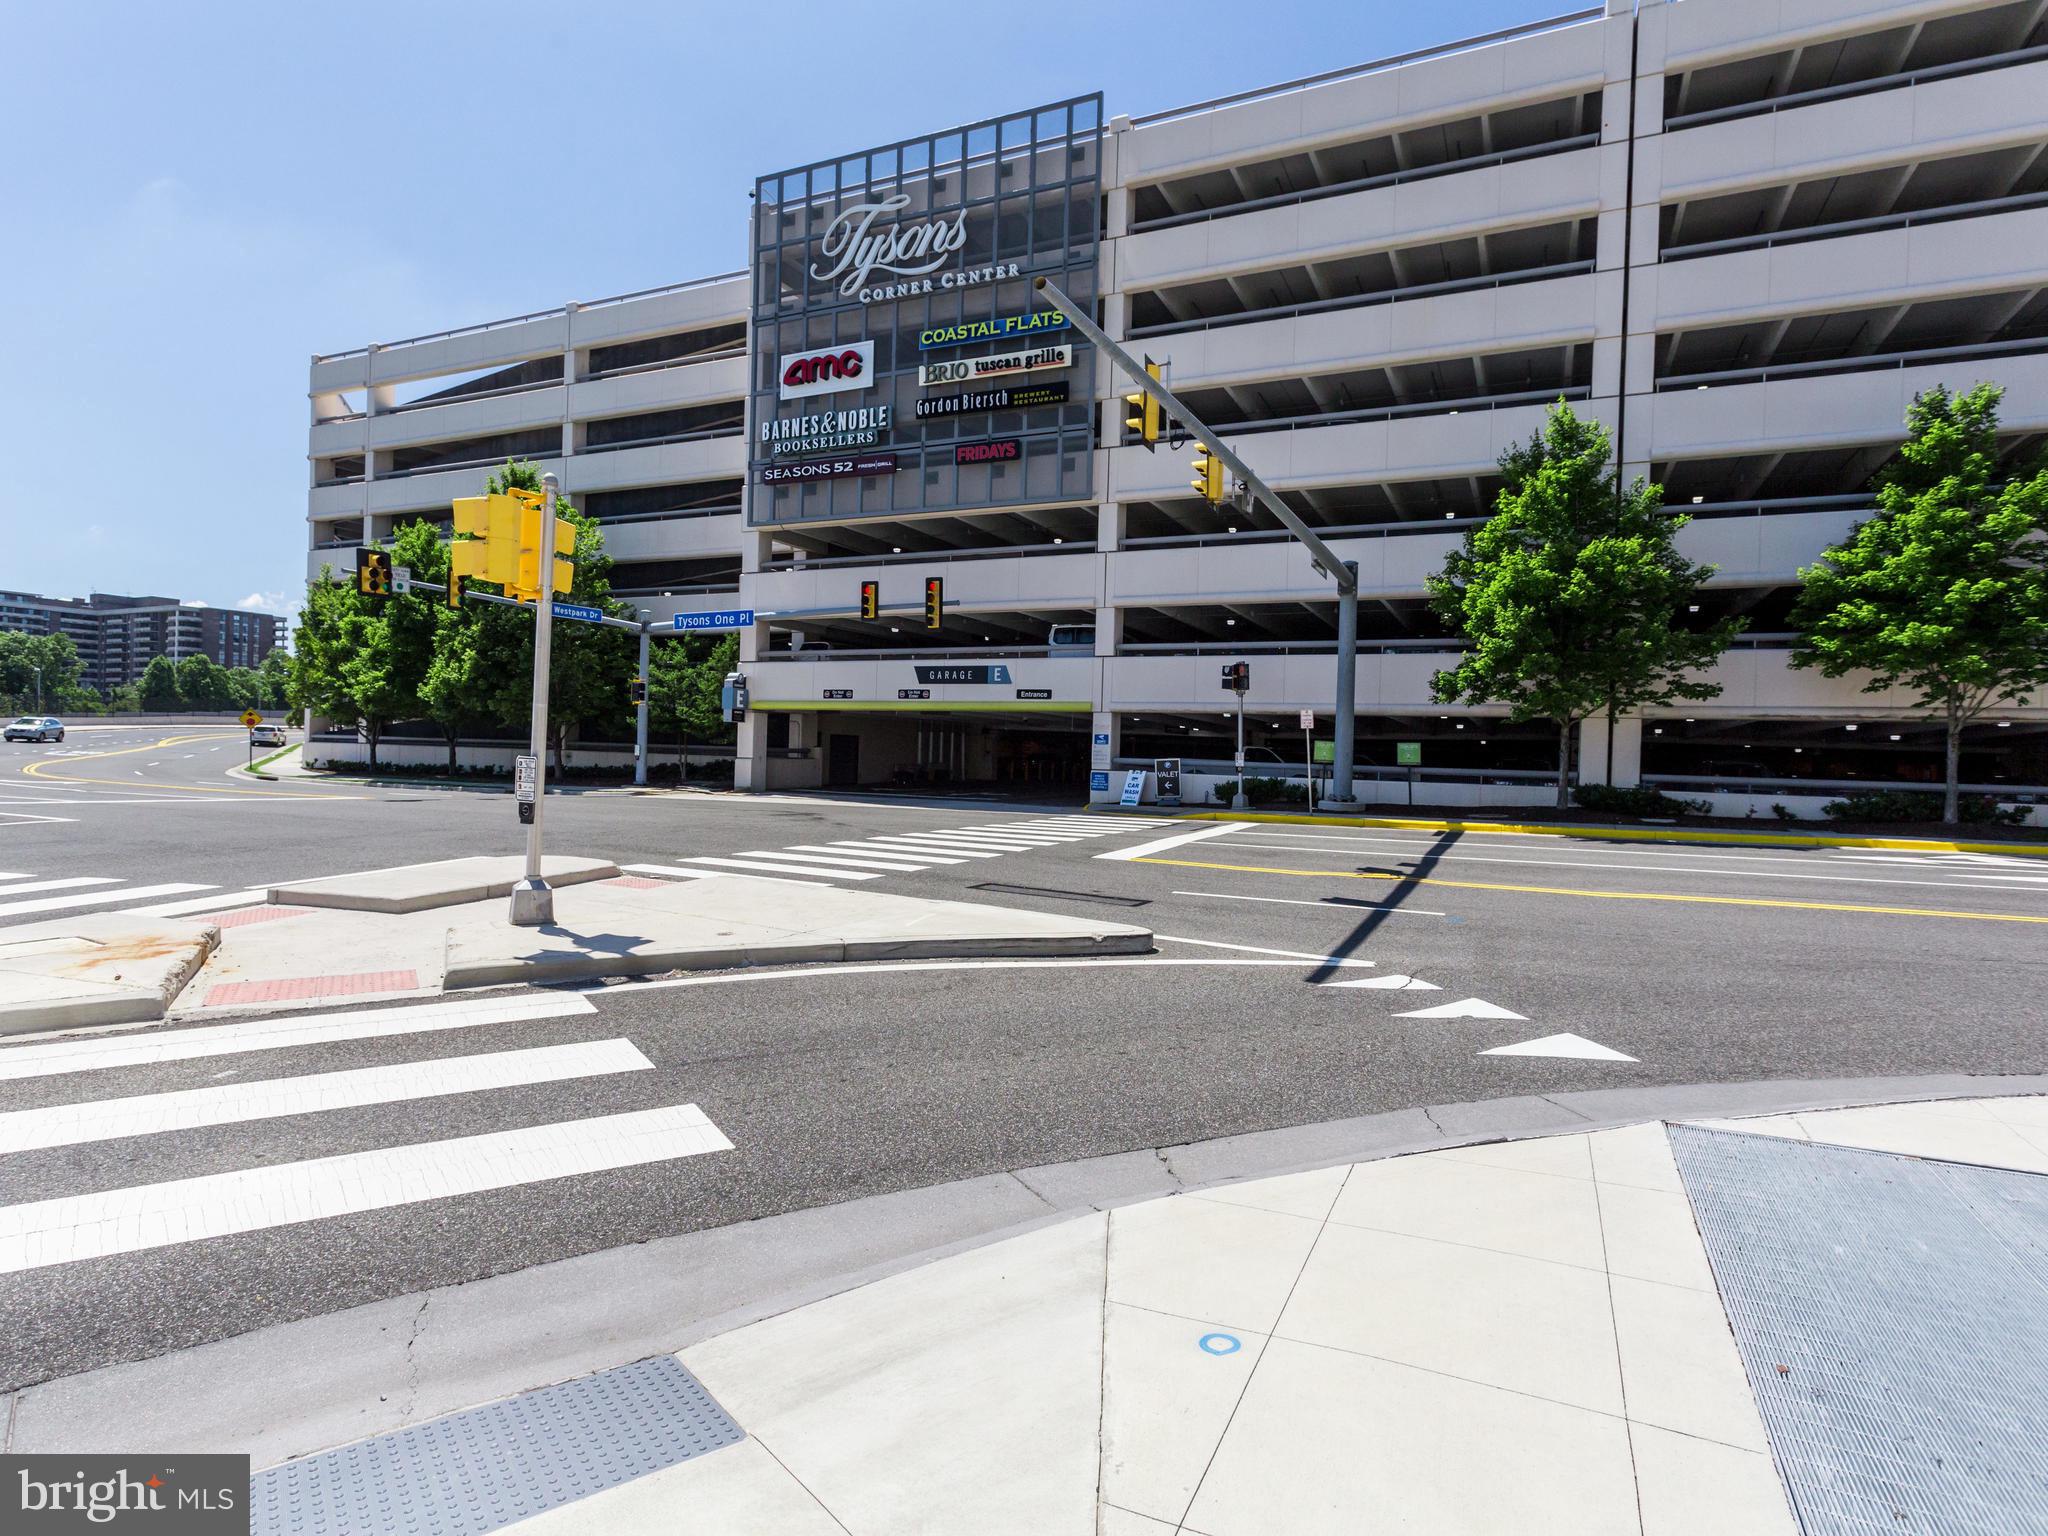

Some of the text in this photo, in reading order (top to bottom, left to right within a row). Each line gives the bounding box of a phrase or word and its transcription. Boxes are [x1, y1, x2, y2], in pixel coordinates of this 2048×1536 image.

[810, 194, 967, 297] Tysons
[859, 263, 1020, 303] CORNER CENTER
[921, 311, 1064, 345] COASTAL FLATS
[923, 347, 1065, 383] BRIO tuscan grille
[916, 389, 1008, 416] Gordon Biersch
[774, 432, 874, 454] BOOKSELLERS
[957, 442, 1016, 462] FRIDAYS
[765, 463, 831, 480] SEASONS
[833, 462, 854, 473] 52
[554, 606, 598, 618] Westpark Dr
[678, 613, 749, 629] Tysons One Pl
[929, 669, 1001, 681] GARAGE E
[737, 690, 744, 708] E
[1157, 770, 1179, 778] VALET
